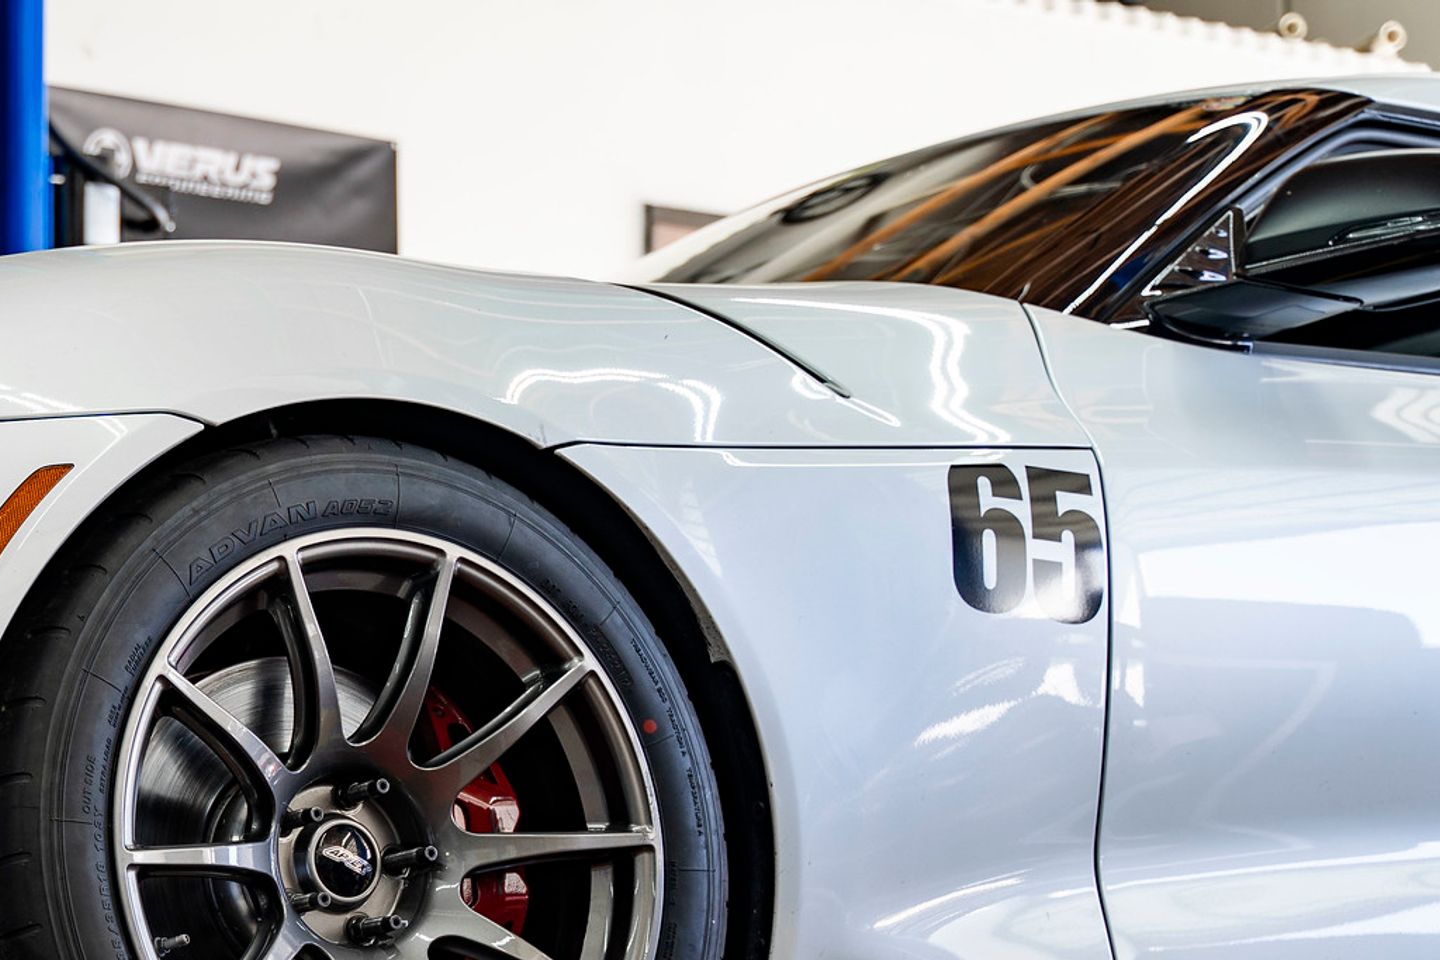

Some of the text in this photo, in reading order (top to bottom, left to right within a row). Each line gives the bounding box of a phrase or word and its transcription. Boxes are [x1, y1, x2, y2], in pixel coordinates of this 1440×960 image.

[132, 137, 281, 189] VERUS
[187, 498, 394, 586] ADVAN A052
[948, 463, 1104, 624] 65
[82, 755, 97, 815] OUTSIDE
